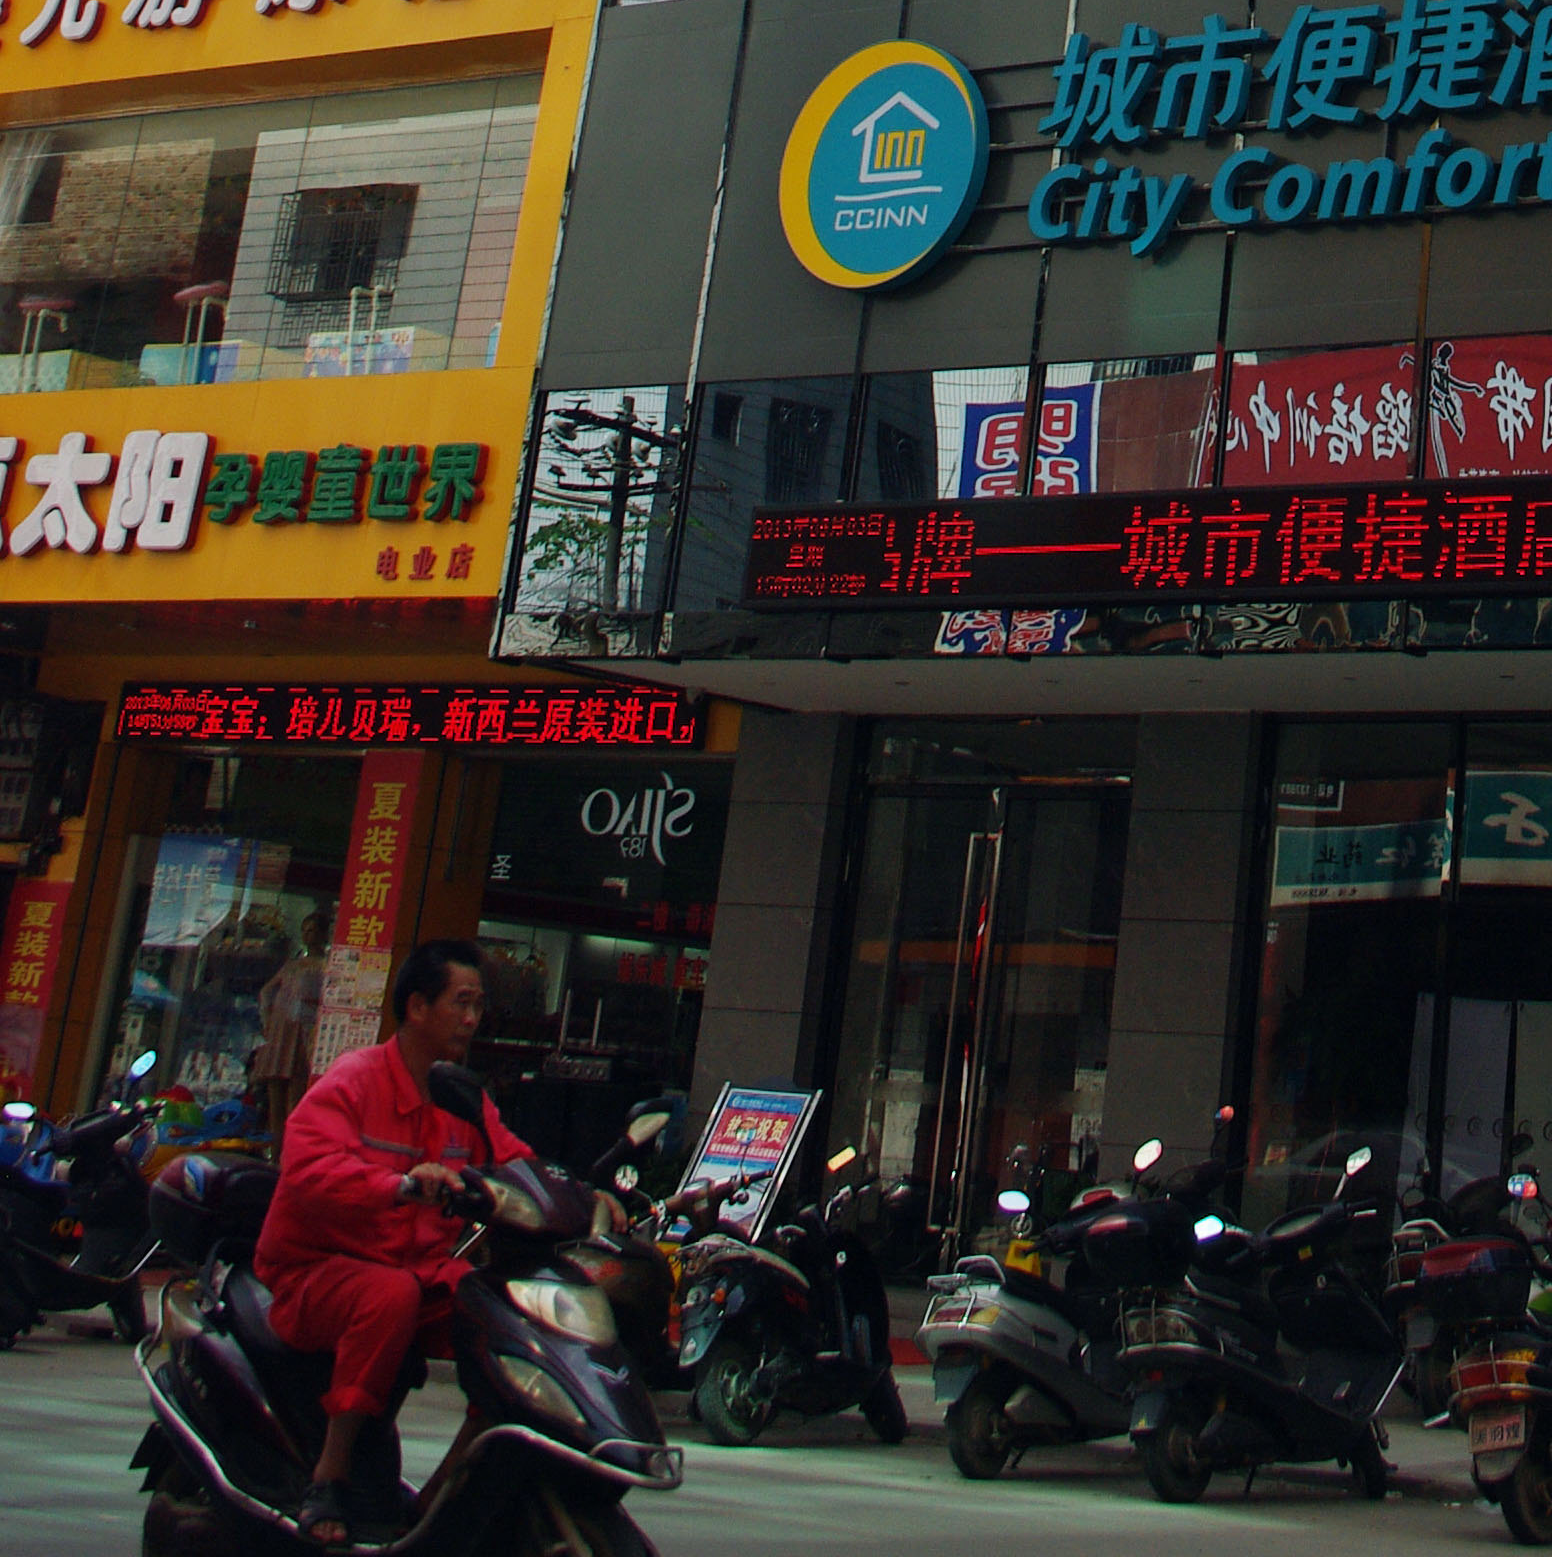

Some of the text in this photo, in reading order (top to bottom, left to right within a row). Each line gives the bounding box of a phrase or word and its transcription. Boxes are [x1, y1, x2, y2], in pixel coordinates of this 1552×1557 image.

[833, 203, 929, 233] CCINN
[1027, 147, 1191, 259] City
[0, 427, 211, 559] 太阳
[375, 543, 477, 583] 电业店
[346, 780, 407, 946] 夏装新款
